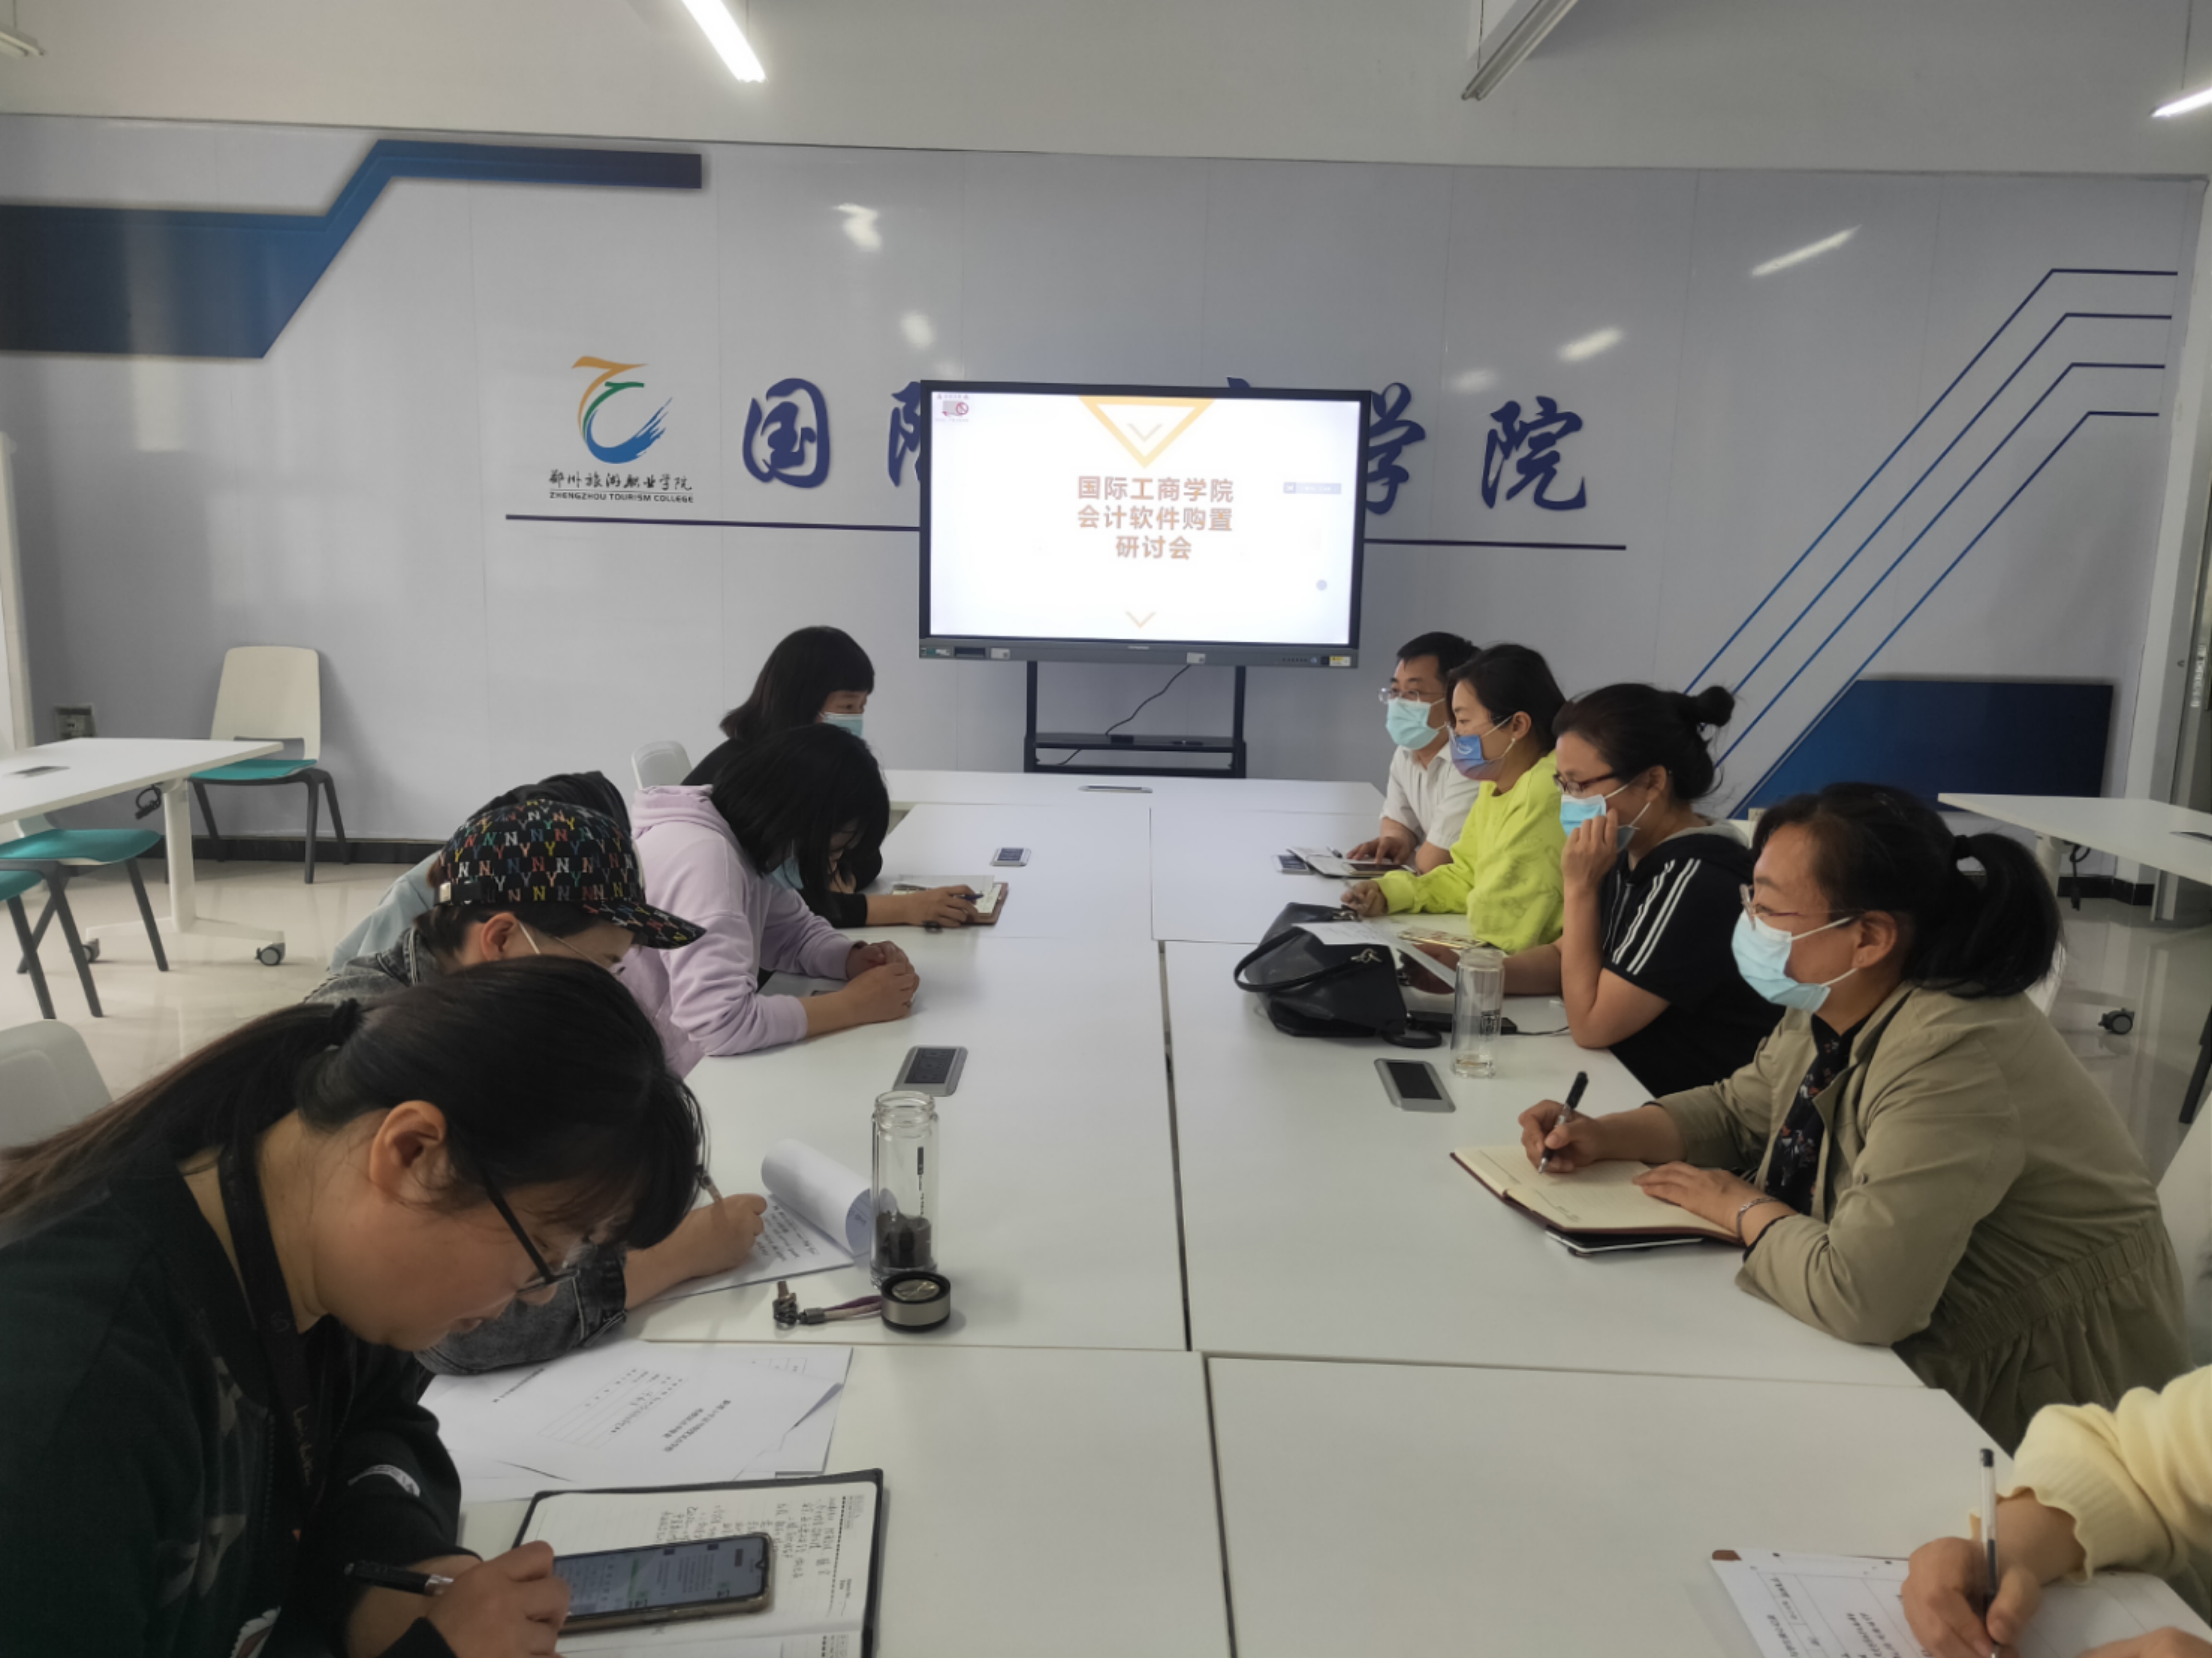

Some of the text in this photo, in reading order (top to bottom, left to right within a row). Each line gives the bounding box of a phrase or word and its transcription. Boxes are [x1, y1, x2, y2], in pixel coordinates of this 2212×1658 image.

[550, 492, 694, 503] ZHENGZHOU TOURISM COLLEGE
[1079, 476, 1233, 502] 国际工商学院
[1078, 505, 1232, 531] 会计软件购置
[1116, 535, 1191, 560] 研讨会
